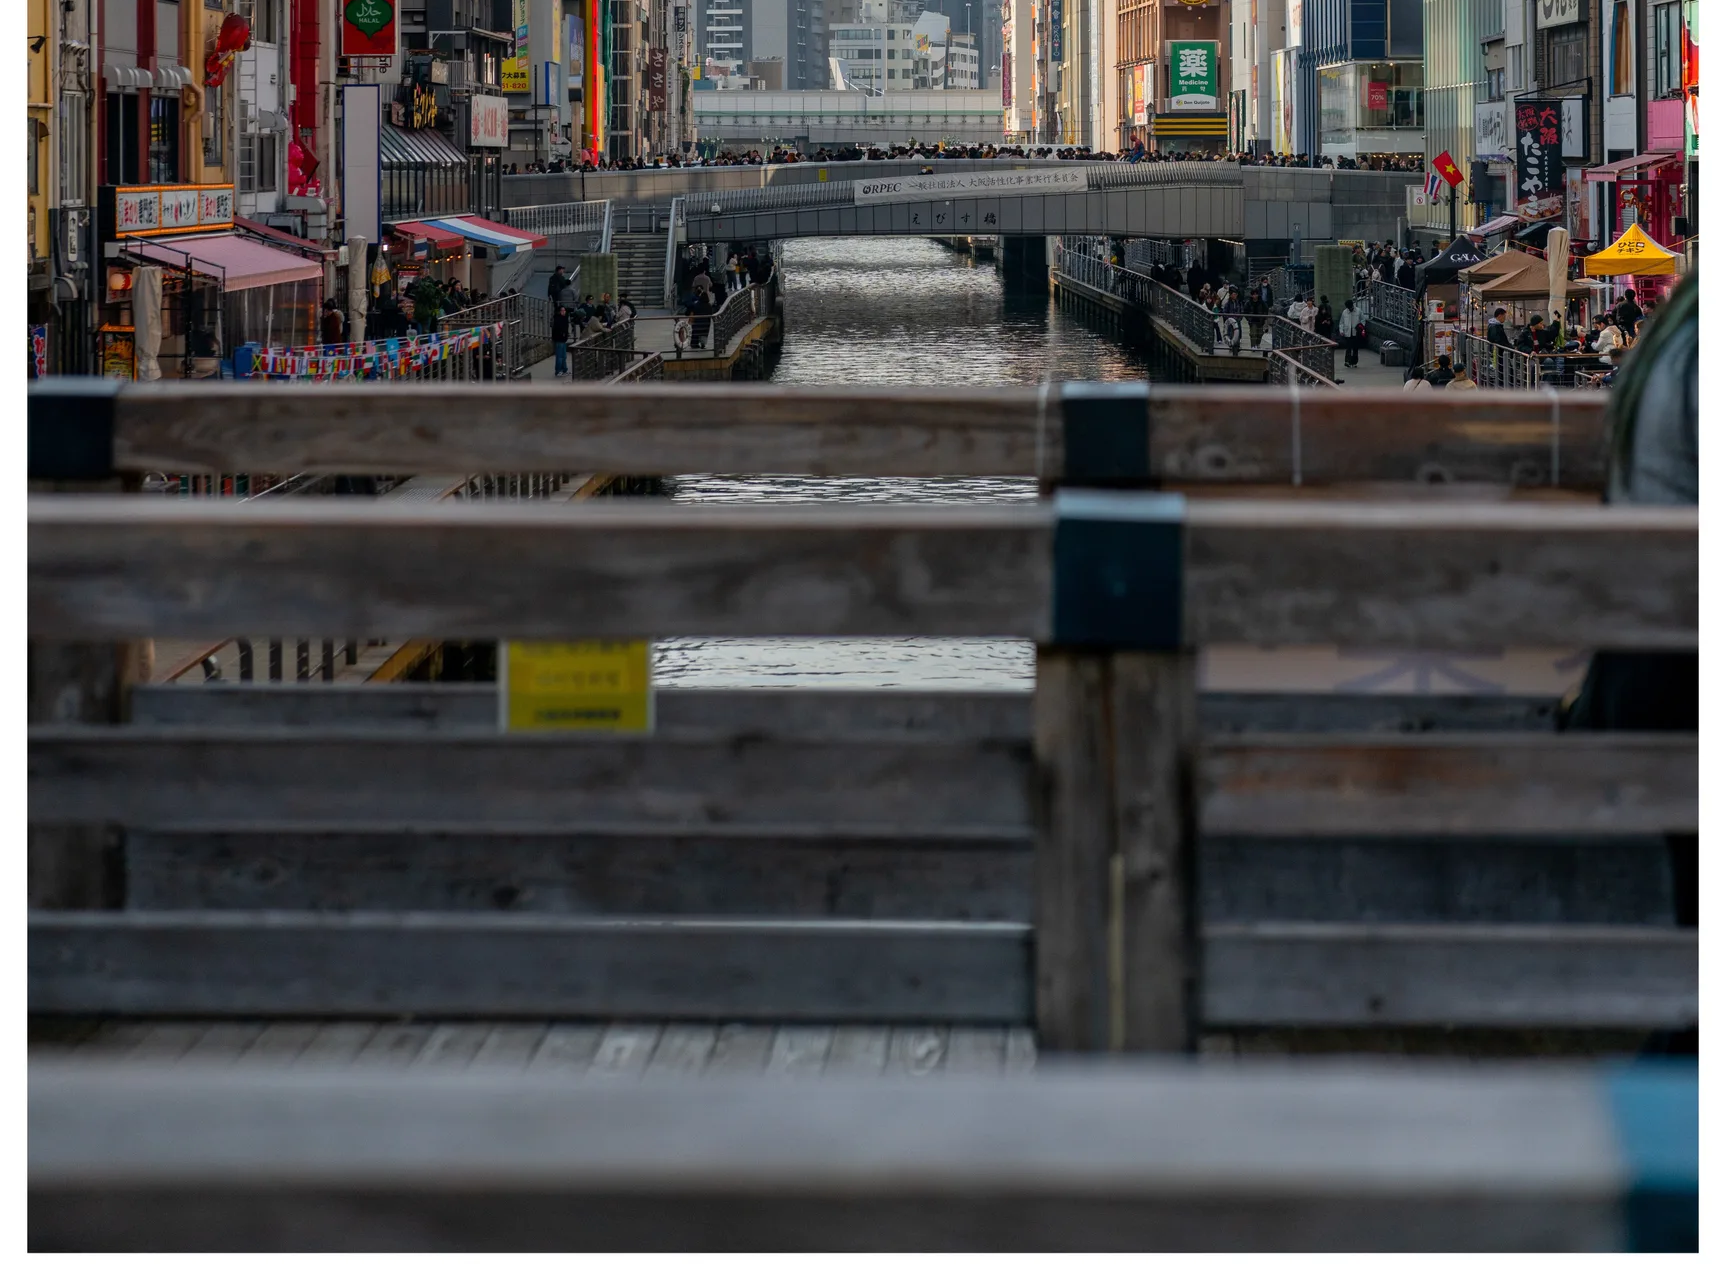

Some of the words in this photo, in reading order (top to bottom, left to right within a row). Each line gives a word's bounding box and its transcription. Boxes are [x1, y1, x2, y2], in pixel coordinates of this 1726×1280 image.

[356, 3, 382, 17] حلال
[1179, 49, 1208, 77] 薬
[1539, 107, 1559, 145] 大阪
[908, 180, 965, 191] 一般社団法人
[968, 173, 1078, 187] 大阪活性化事業実行委員会
[1520, 132, 1543, 216] たこやき
[912, 213, 996, 225] えびす橋
